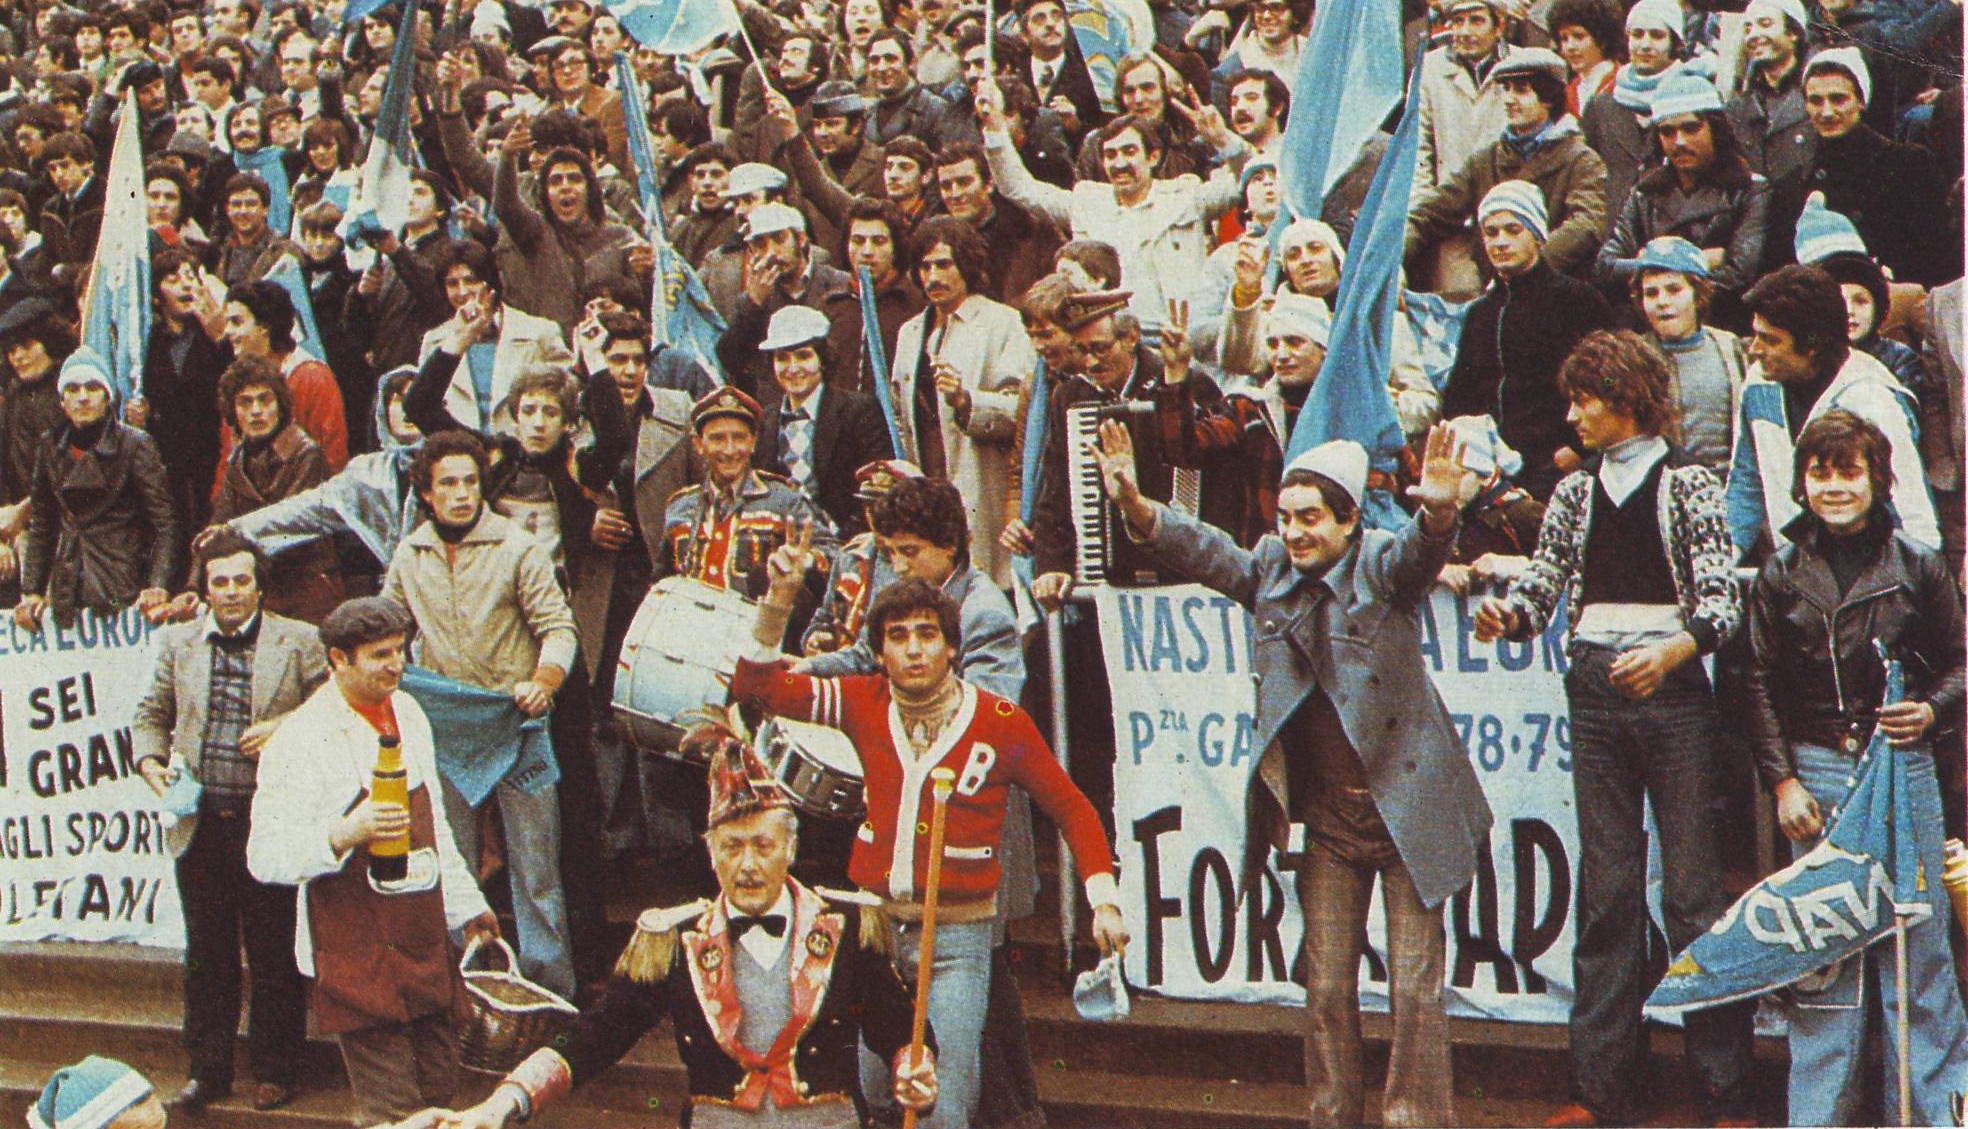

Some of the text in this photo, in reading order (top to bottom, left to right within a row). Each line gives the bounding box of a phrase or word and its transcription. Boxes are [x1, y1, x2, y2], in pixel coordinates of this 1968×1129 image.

[29, 672, 97, 729] SEI
[1198, 712, 1254, 767] GA
[957, 741, 996, 796] B
